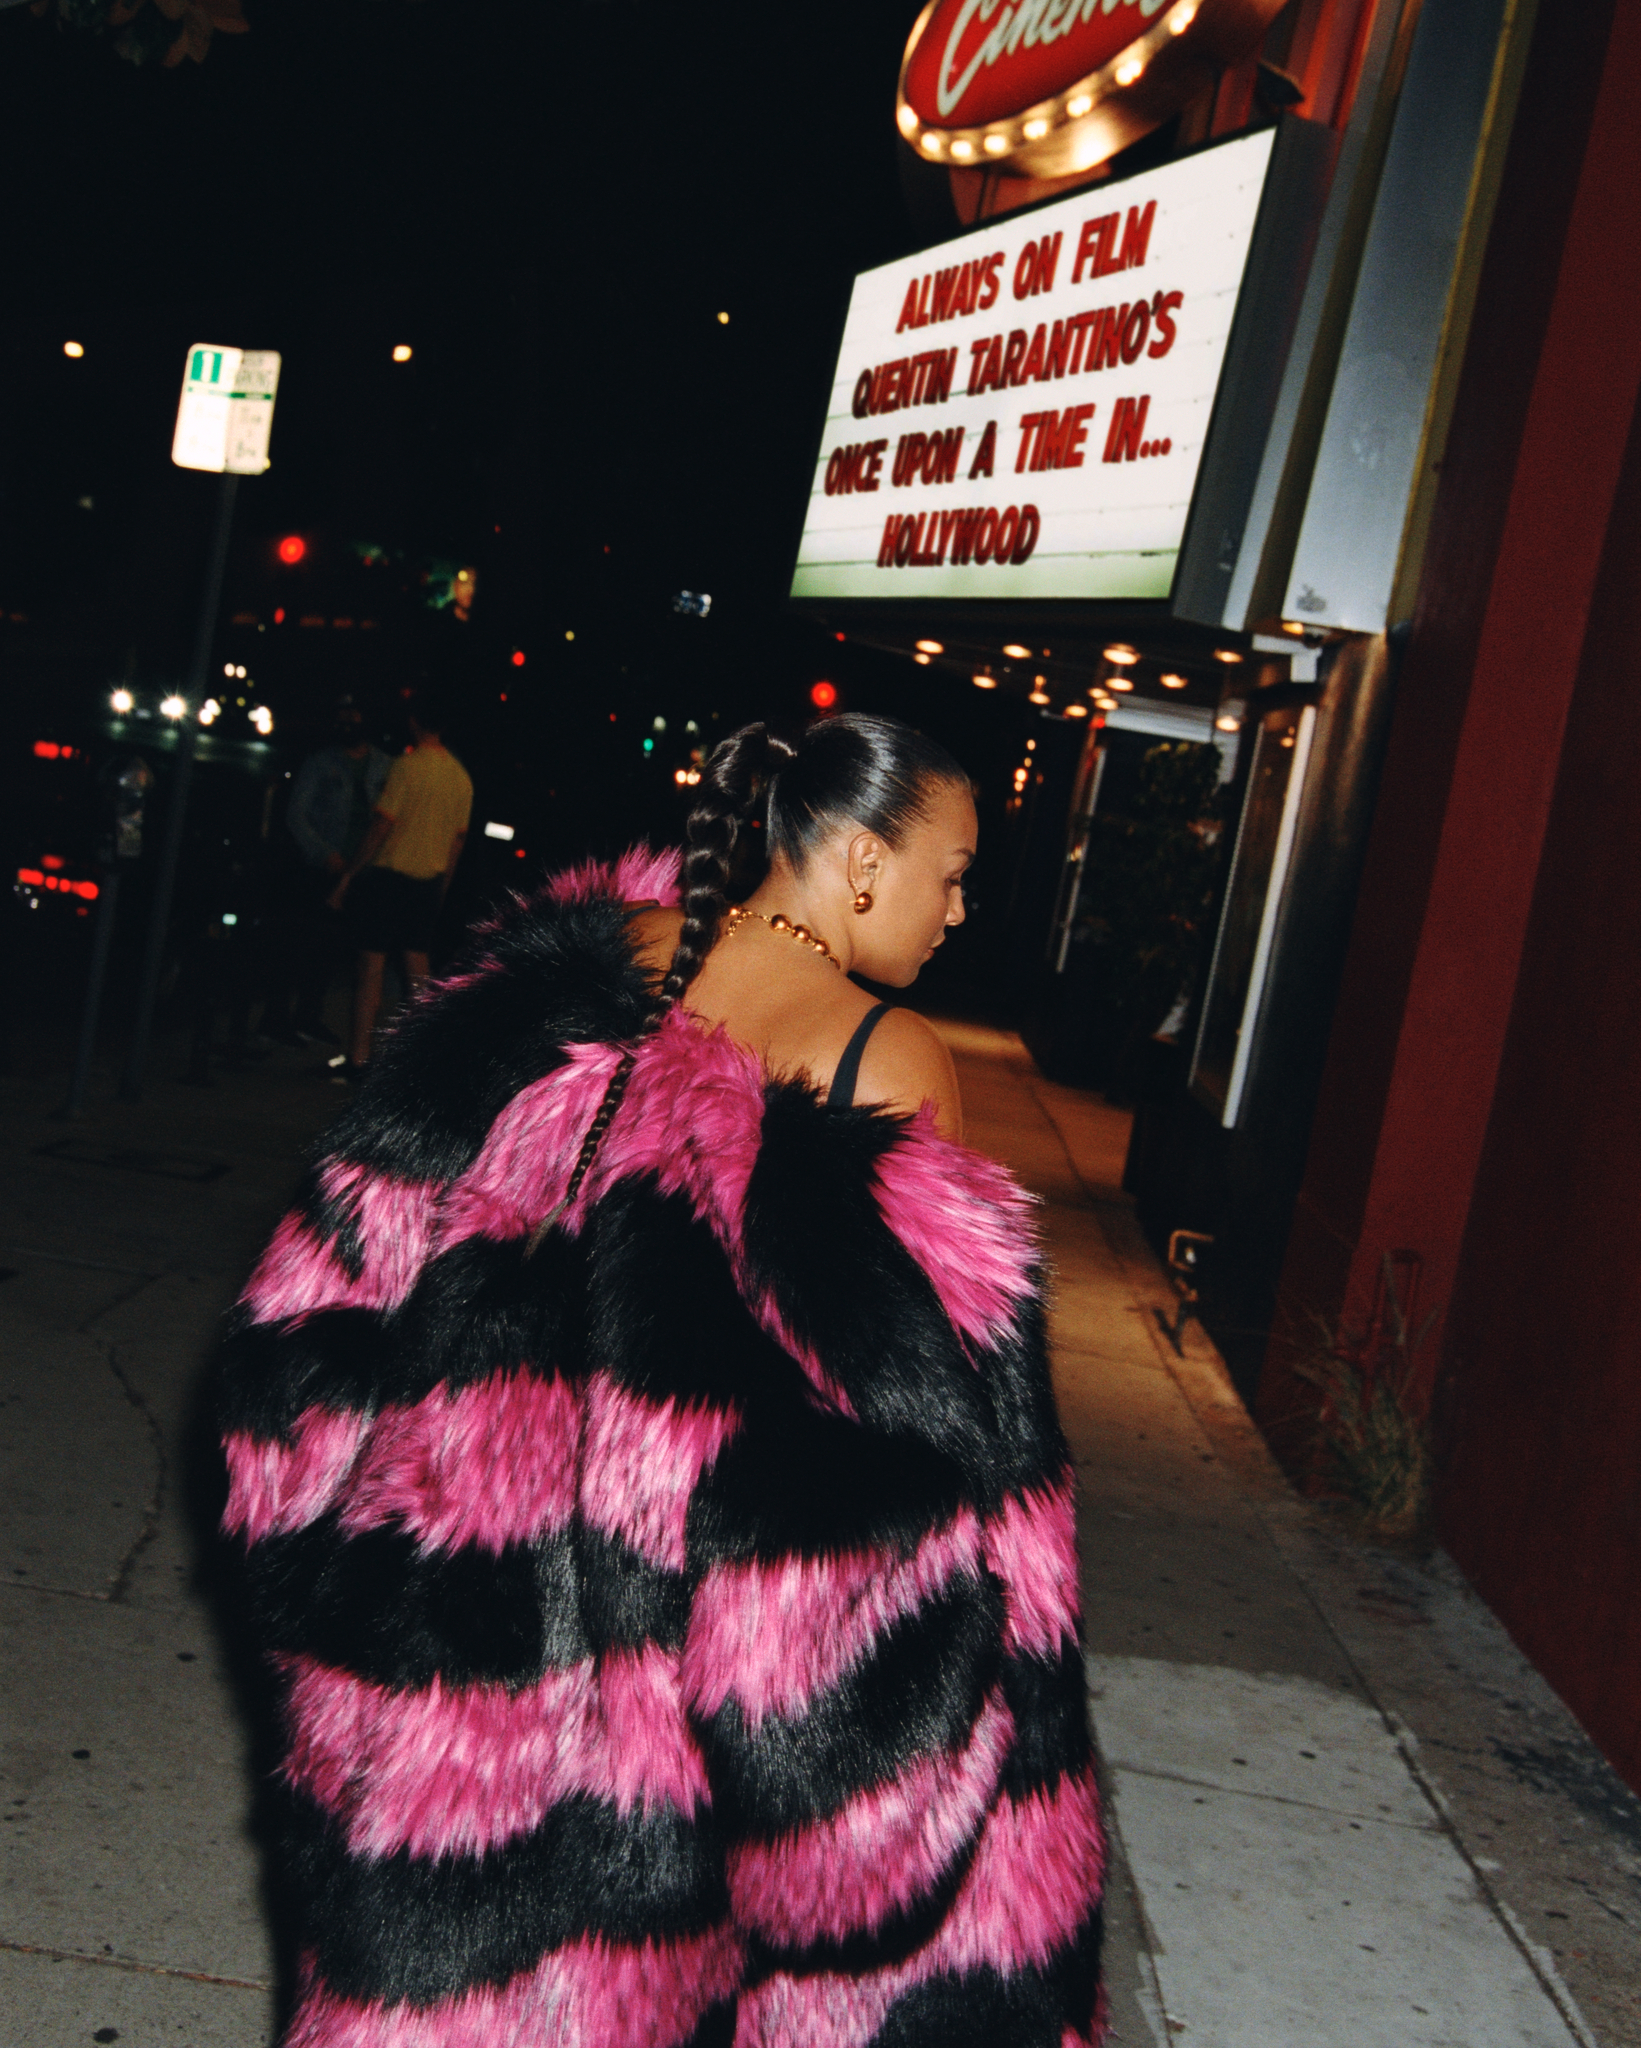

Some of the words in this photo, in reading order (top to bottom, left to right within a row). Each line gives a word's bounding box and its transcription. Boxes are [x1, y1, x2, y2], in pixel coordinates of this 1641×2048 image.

[896, 252, 1004, 333] ALWAYS
[1013, 232, 1062, 300] ON
[1072, 201, 1157, 283] FILM
[852, 347, 957, 419] QUENTIN
[966, 291, 1183, 396] TARANTINO'S
[825, 439, 888, 496] ONCE
[892, 427, 964, 487] UPON
[969, 421, 997, 479] A
[1015, 403, 1095, 473] TIME
[1103, 395, 1171, 463] IN...
[877, 505, 1040, 568] HOLLYWOOD
